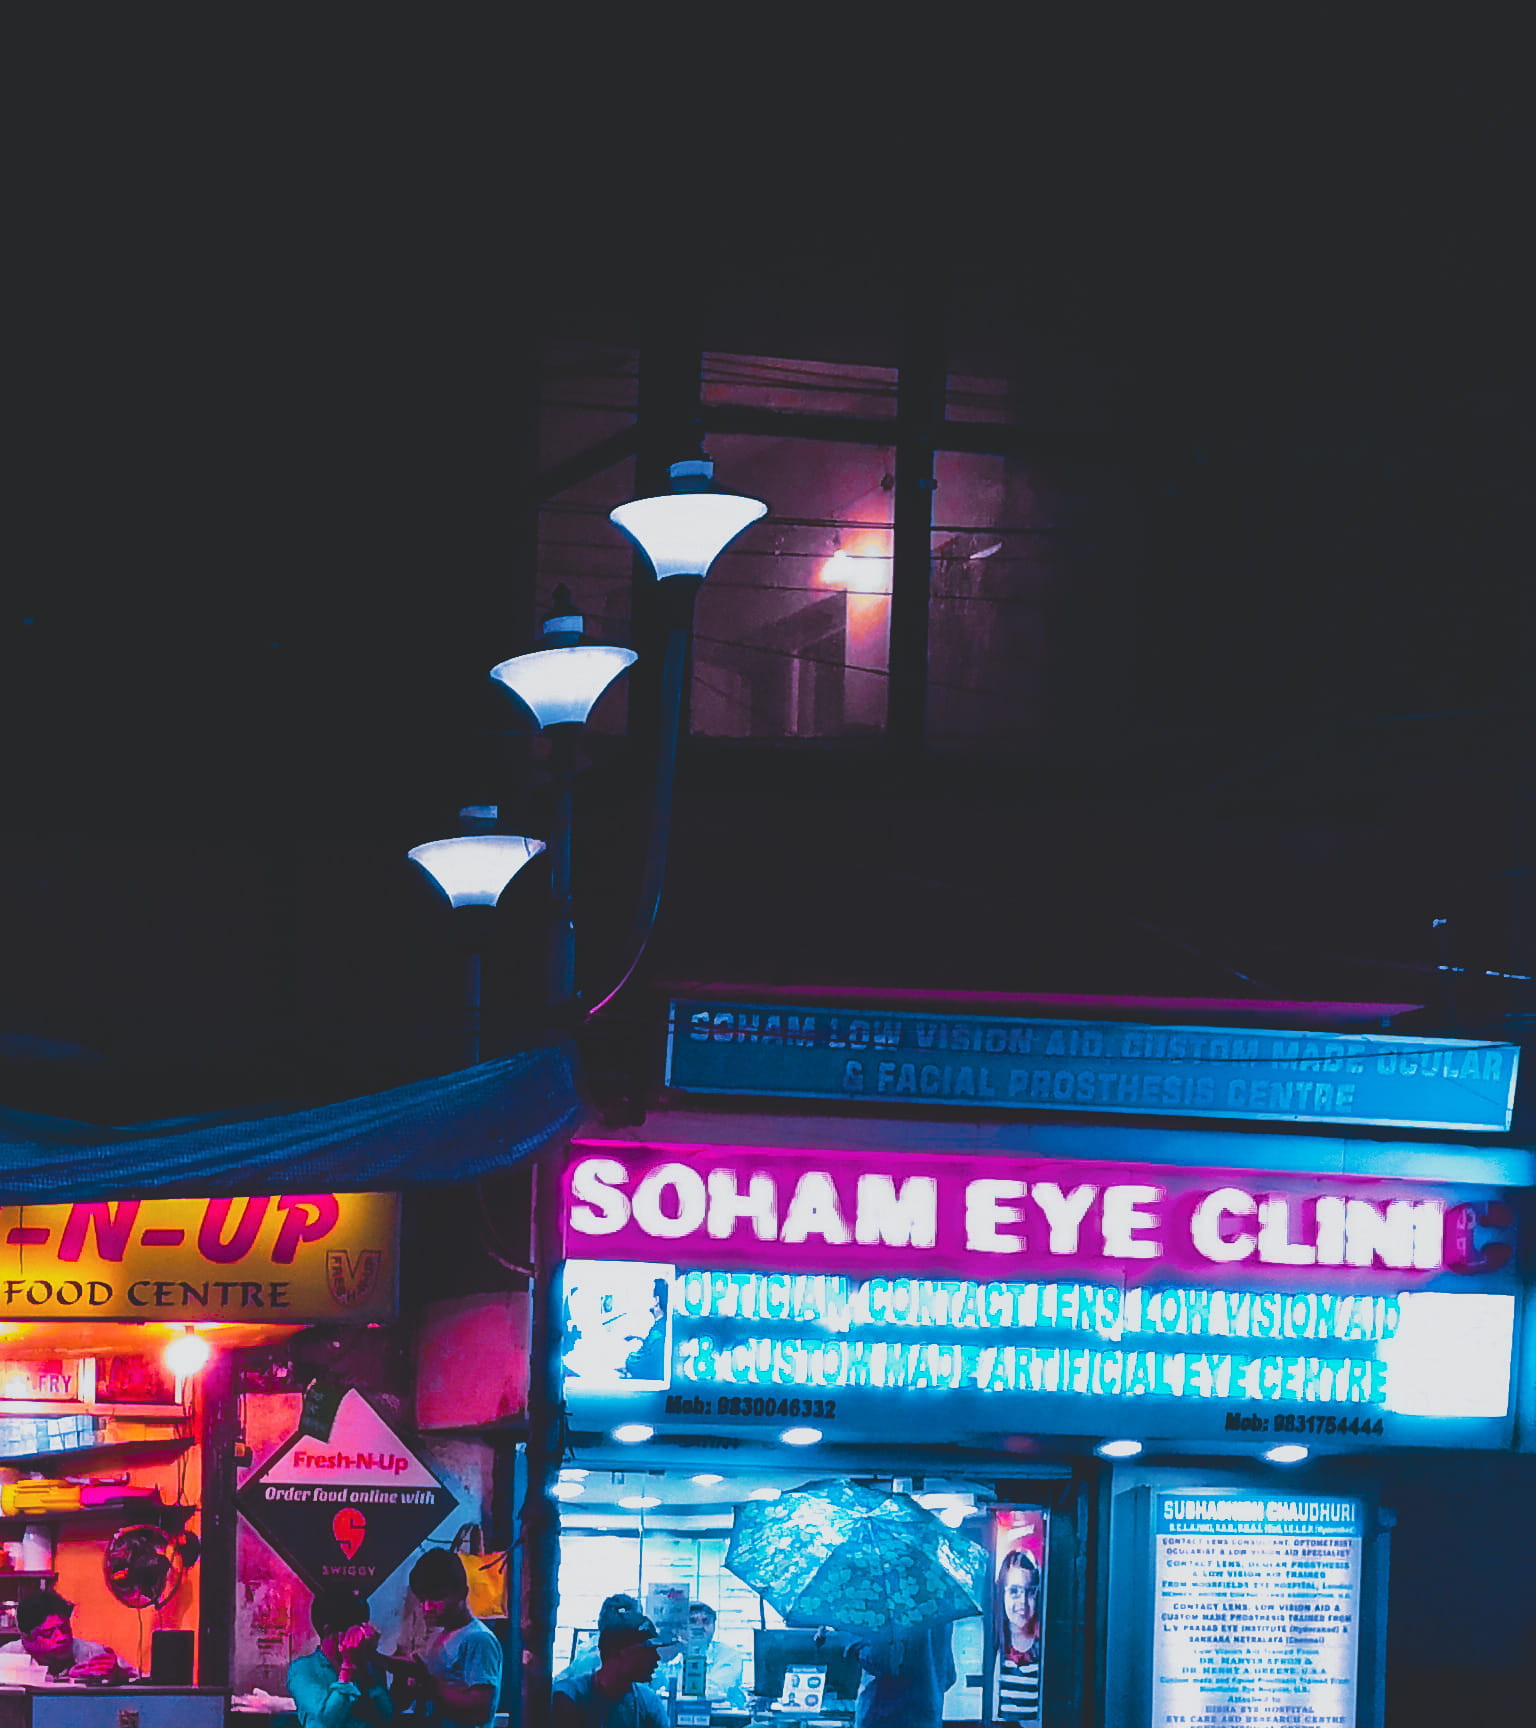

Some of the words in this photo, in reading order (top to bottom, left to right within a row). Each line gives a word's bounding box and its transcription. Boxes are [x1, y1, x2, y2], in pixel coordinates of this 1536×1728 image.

[690, 1011, 817, 1048] SOHAM
[828, 1017, 902, 1051] LOW
[916, 1021, 1031, 1054] VISION
[1127, 1031, 1259, 1063] CUSTOM
[1271, 1039, 1365, 1074] MADE
[1376, 1048, 1504, 1080] OCULAR
[877, 1061, 995, 1097] FACIAL
[1008, 1069, 1216, 1105] PROSTHESIS
[1228, 1080, 1357, 1113] CENTRE
[567, 1159, 939, 1248] SOHAM
[964, 1179, 1165, 1259] EYE
[5, 1279, 113, 1306] FOOD
[128, 1280, 290, 1308] CENTRE
[869, 1278, 1027, 1327] CONTACT
[1185, 1354, 1248, 1397] EYE
[1260, 1357, 1387, 1402] CENTRE
[666, 1396, 712, 1416] Mob:
[1225, 1412, 1269, 1431] Mob:
[293, 1451, 409, 1475] Fresh-N-Up
[265, 1487, 311, 1500] Order
[313, 1487, 347, 1502] food
[350, 1488, 397, 1504] online
[401, 1491, 435, 1505] with
[322, 1566, 376, 1576] SWIGGY
